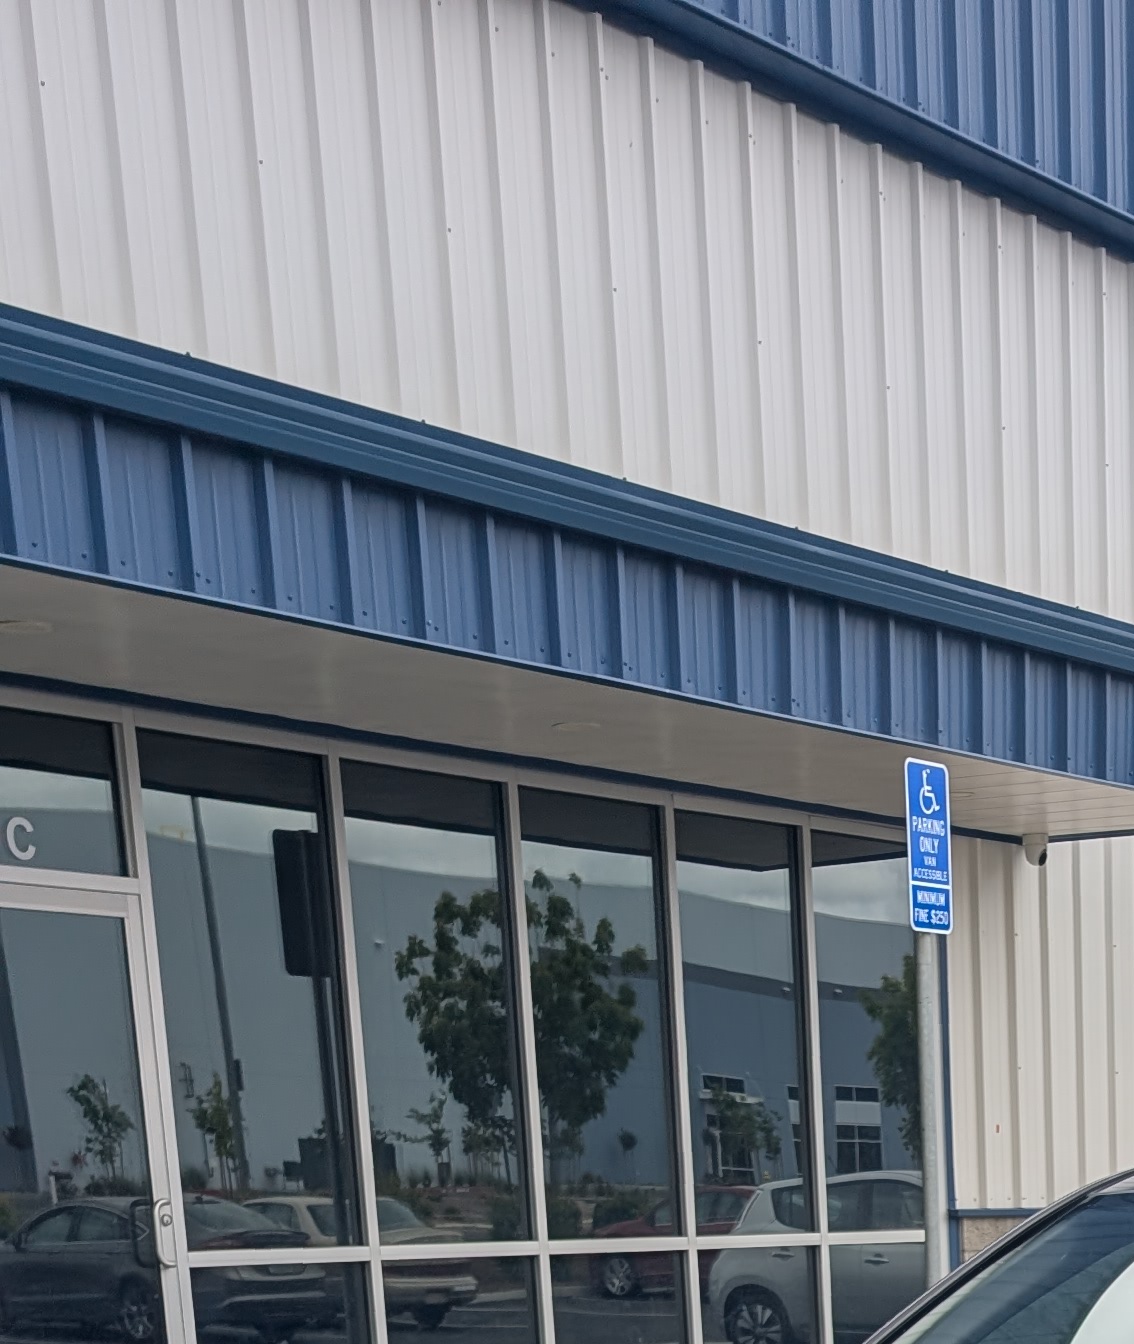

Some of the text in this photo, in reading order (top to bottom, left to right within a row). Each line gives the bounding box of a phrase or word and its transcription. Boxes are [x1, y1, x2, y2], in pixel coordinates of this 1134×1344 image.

[913, 816, 945, 837] PARKING
[7, 817, 37, 861] C
[920, 836, 939, 854] ONLY
[924, 856, 937, 867] VAN
[915, 868, 947, 882] ACCESSIBLE
[917, 890, 946, 907] MINIMUM
[915, 908, 948, 925] FINE $250
